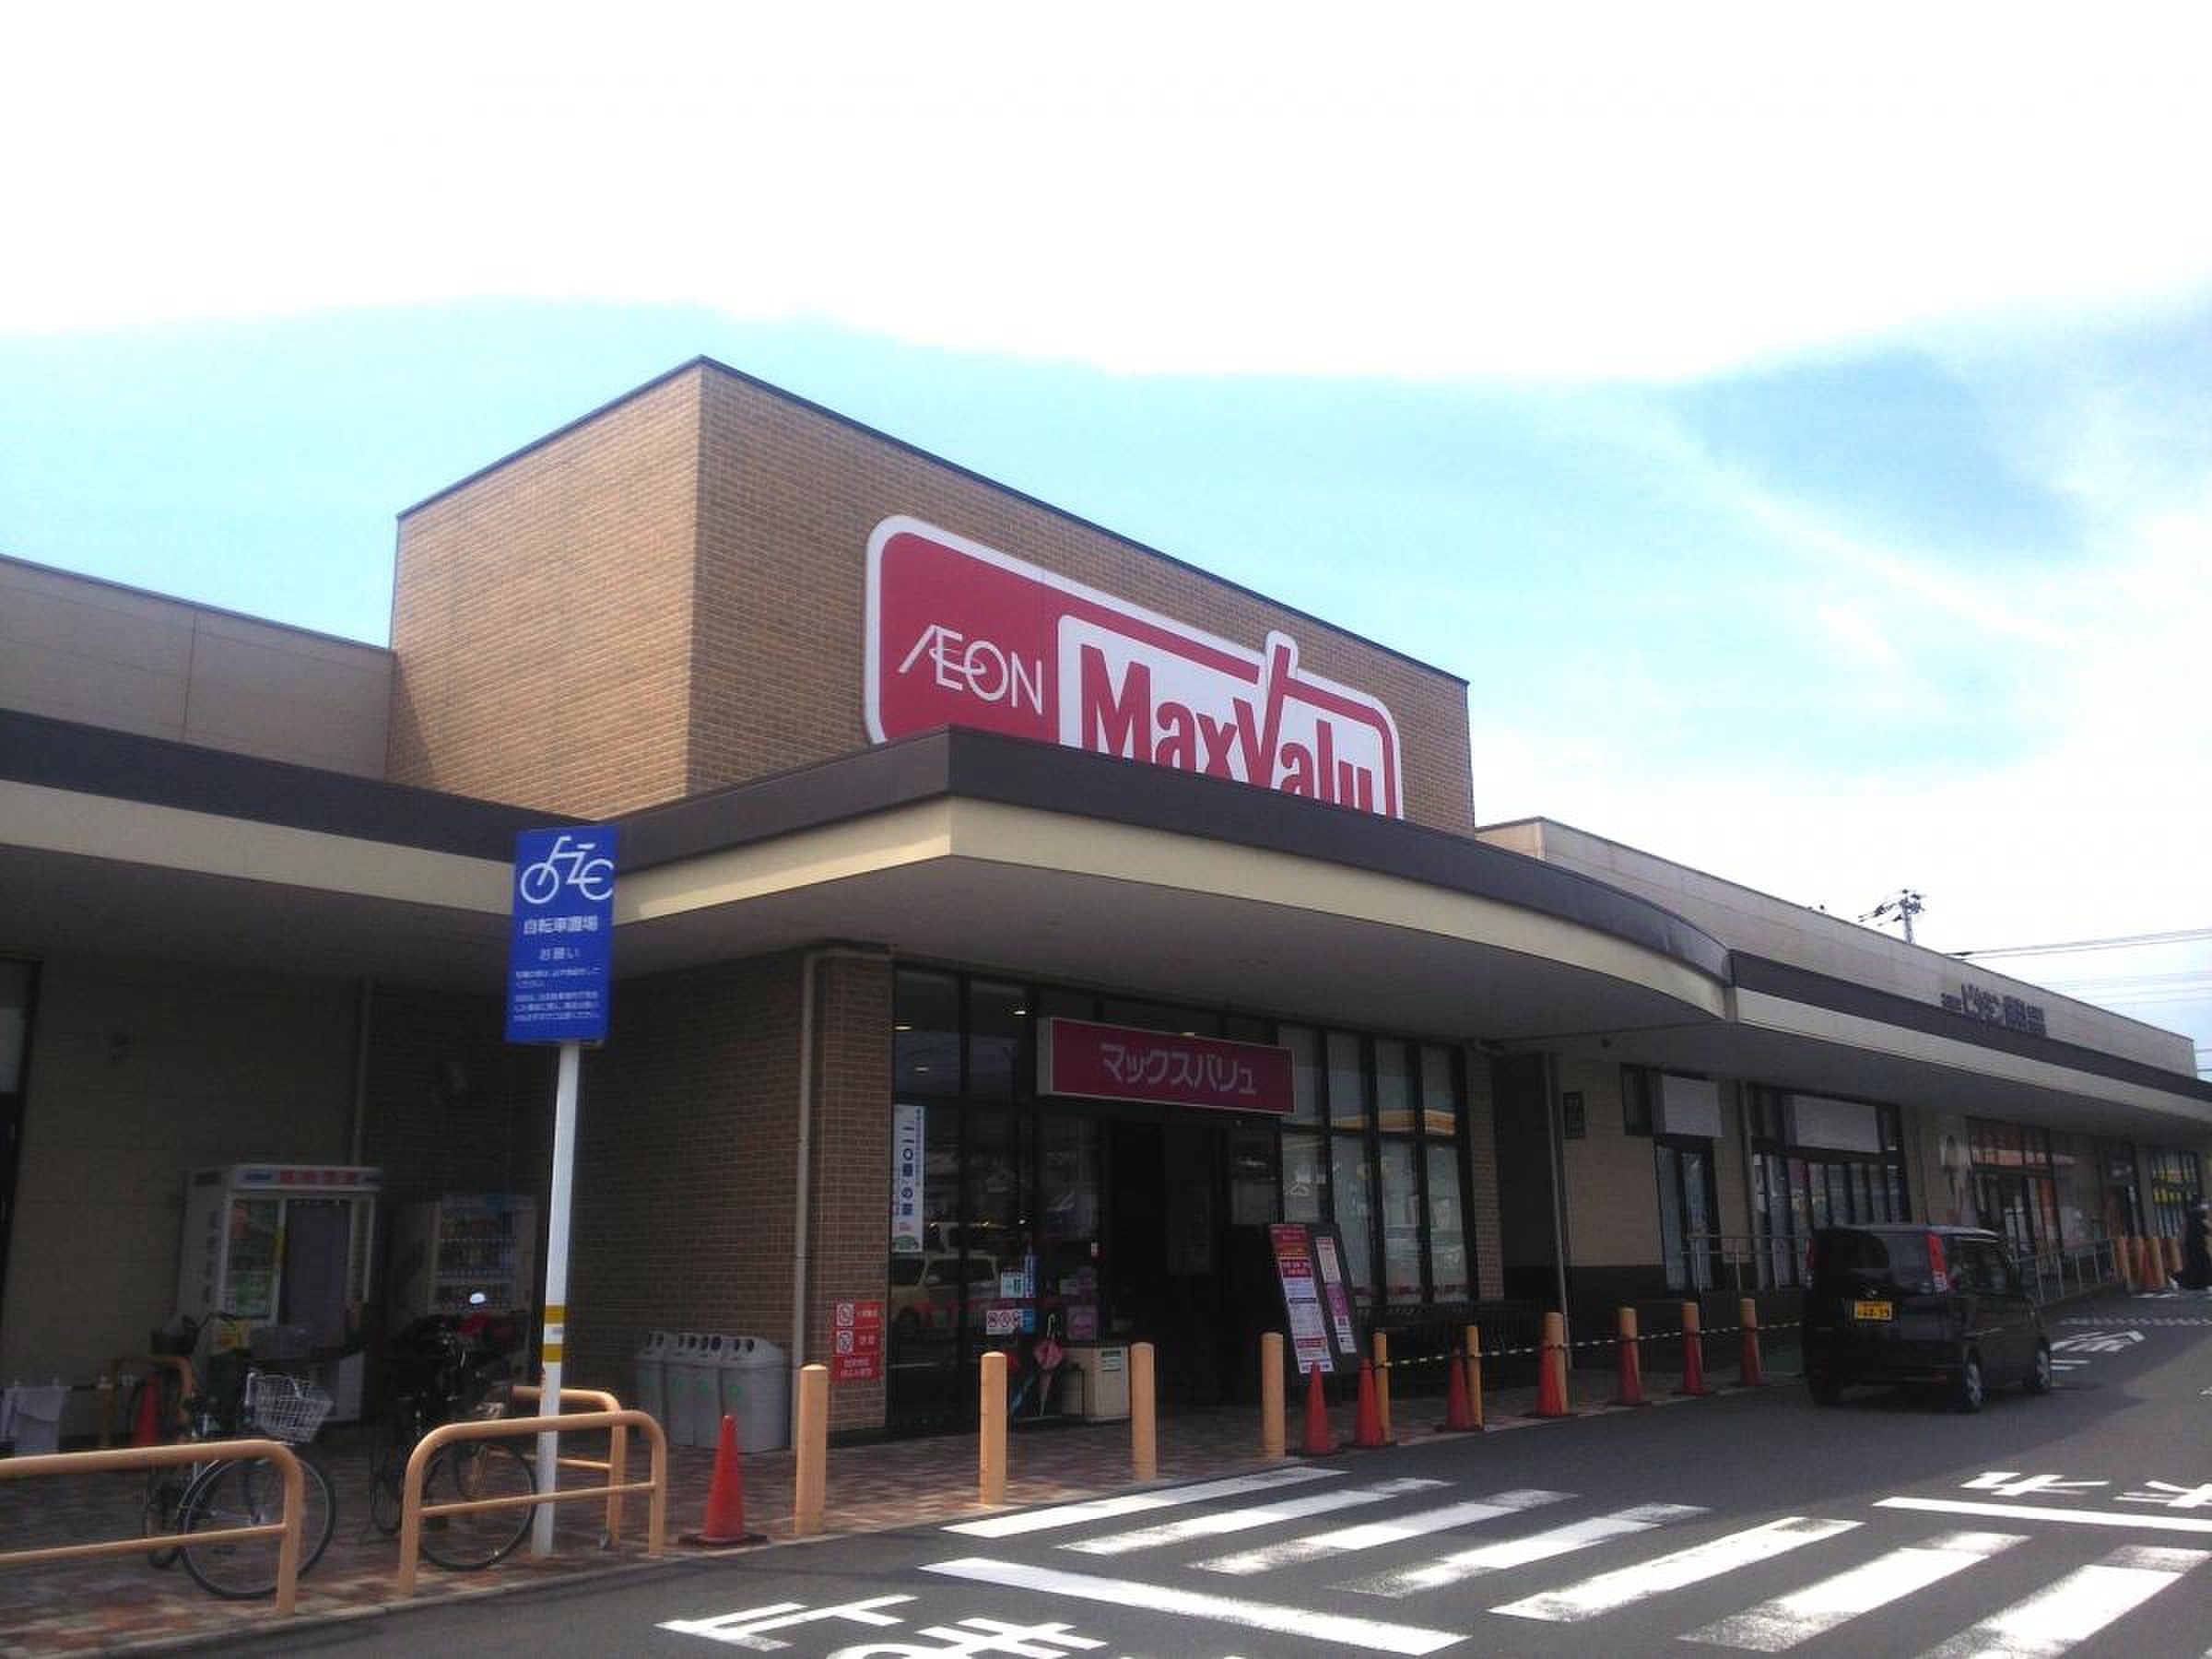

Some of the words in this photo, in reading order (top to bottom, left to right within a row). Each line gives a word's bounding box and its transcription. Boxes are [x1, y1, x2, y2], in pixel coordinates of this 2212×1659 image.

[1080, 643, 1373, 815] MaxValu
[1099, 1042, 1258, 1095] マックスバリュ
